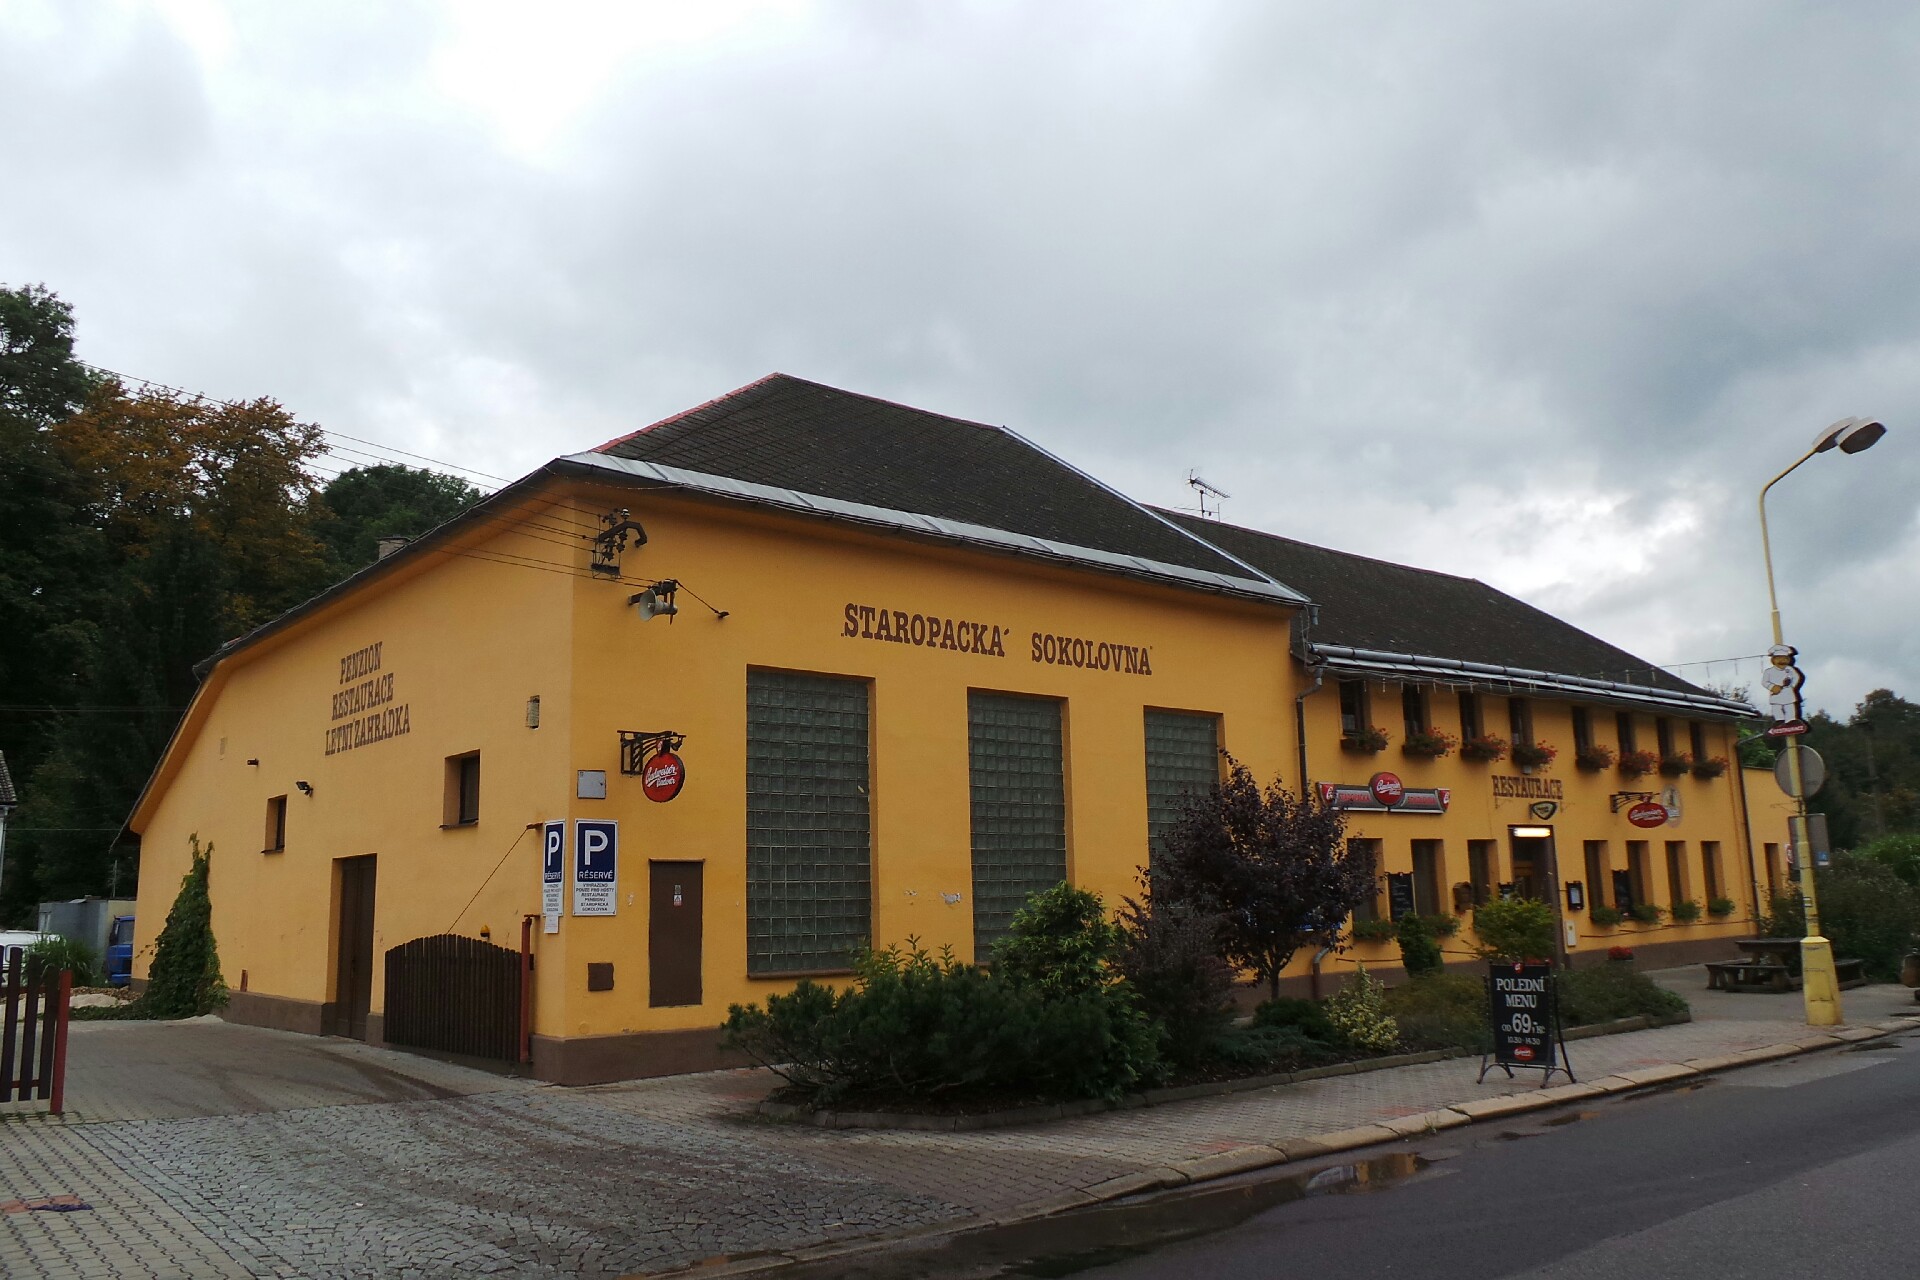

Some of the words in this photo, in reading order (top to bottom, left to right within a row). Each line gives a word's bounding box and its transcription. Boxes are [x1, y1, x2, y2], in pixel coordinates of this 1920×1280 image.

[339, 641, 383, 685] PENZION
[331, 672, 394, 721] RESTAURACE
[354, 703, 411, 747] ZAHRÁDKA
[1491, 775, 1563, 800] RESTAURACE
[547, 831, 560, 867] P
[584, 829, 608, 866] P
[578, 869, 614, 880] RÉSERVÉ
[1495, 976, 1545, 992] POLEDNÍ
[1505, 994, 1537, 1008] MENU
